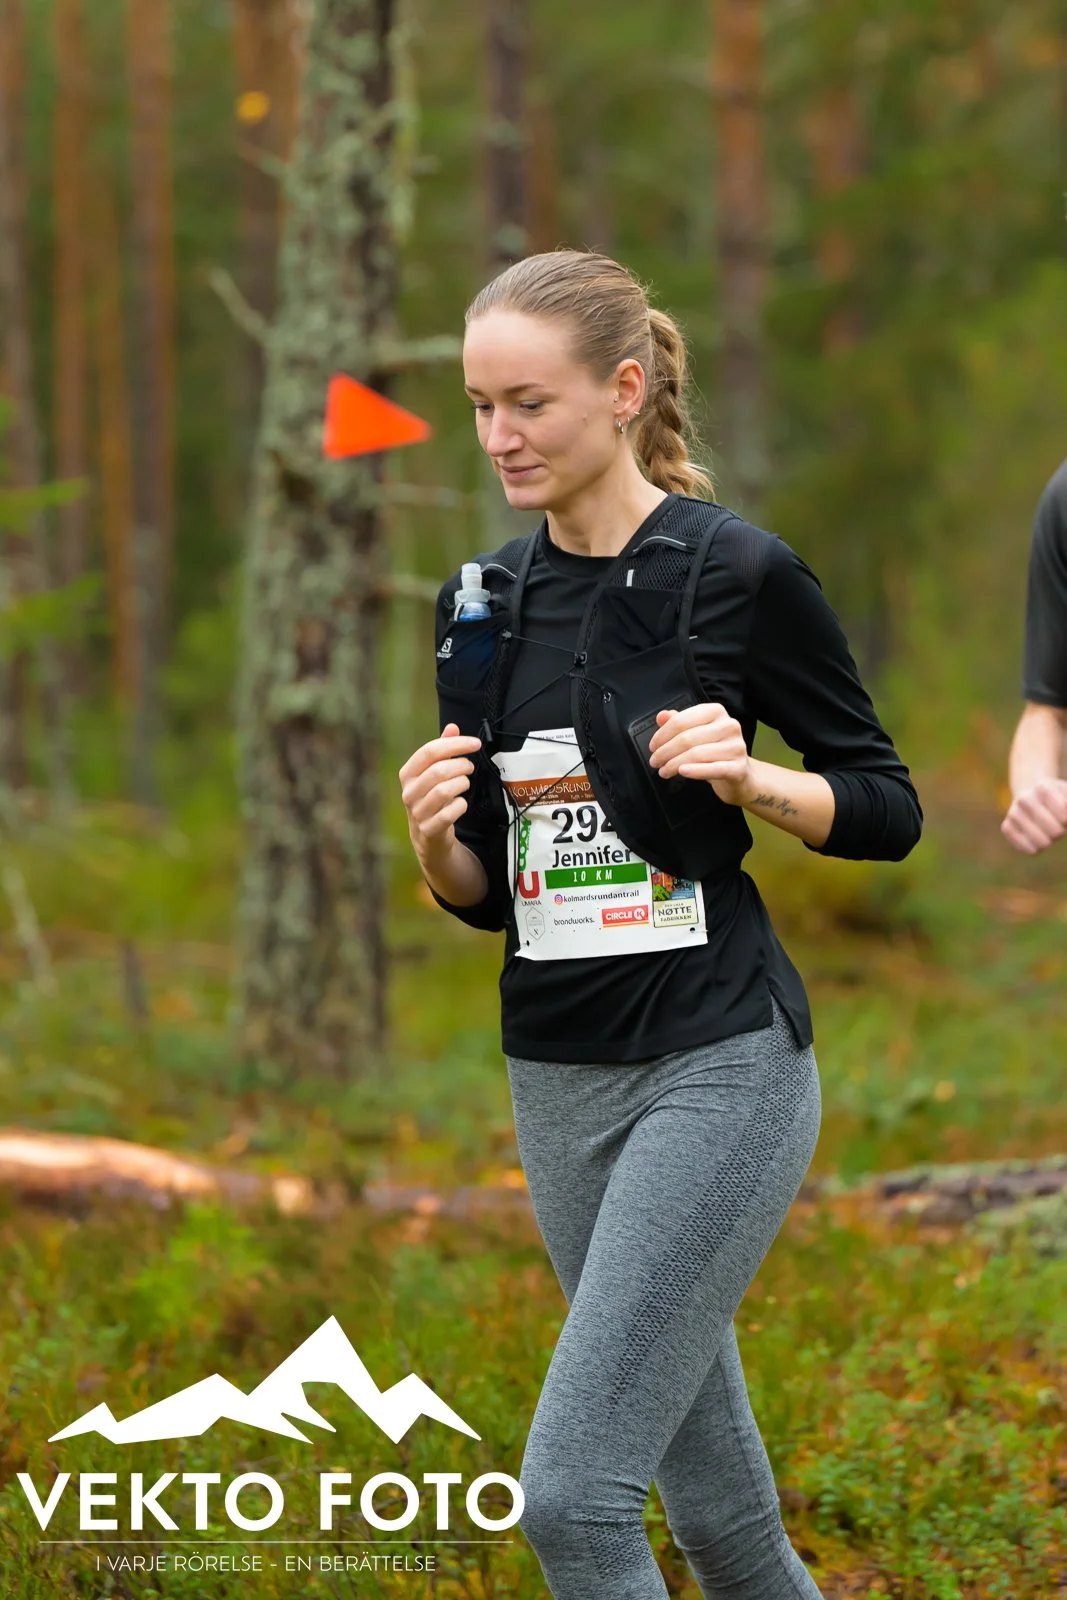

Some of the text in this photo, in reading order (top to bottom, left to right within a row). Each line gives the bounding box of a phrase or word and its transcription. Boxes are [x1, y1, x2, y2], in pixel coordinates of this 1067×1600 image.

[552, 844, 632, 869] Jennifer
[572, 869, 614, 883] 10 KM
[563, 889, 640, 903] kolmardsrundantrail
[605, 908, 645, 921] CIRCLE K
[657, 905, 693, 917] NØTTE
